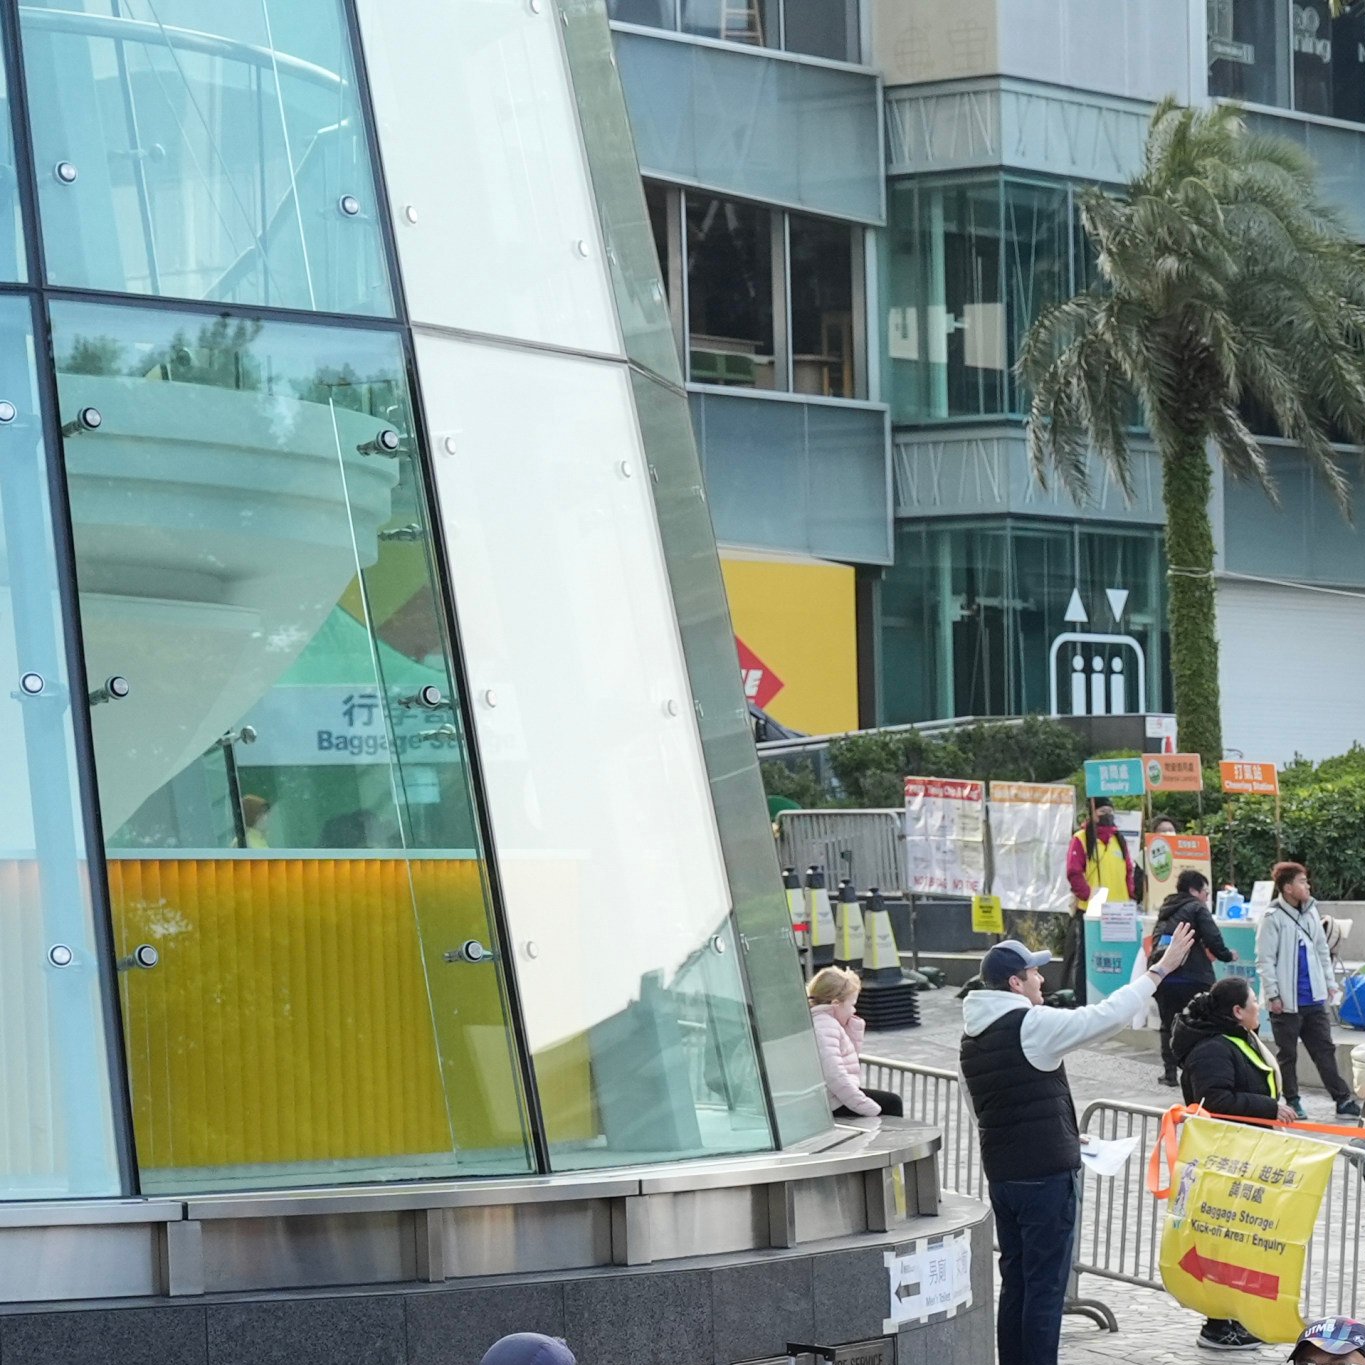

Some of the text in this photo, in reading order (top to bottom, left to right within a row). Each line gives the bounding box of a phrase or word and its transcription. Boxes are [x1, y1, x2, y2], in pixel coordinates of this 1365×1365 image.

[1258, 1164, 1298, 1186] 起步區
[1200, 1201, 1275, 1232] Baggage Storage
[1224, 1227, 1244, 1242] Area
[1252, 1233, 1287, 1256] Enquiry
[1304, 1322, 1336, 1338] UTMB
